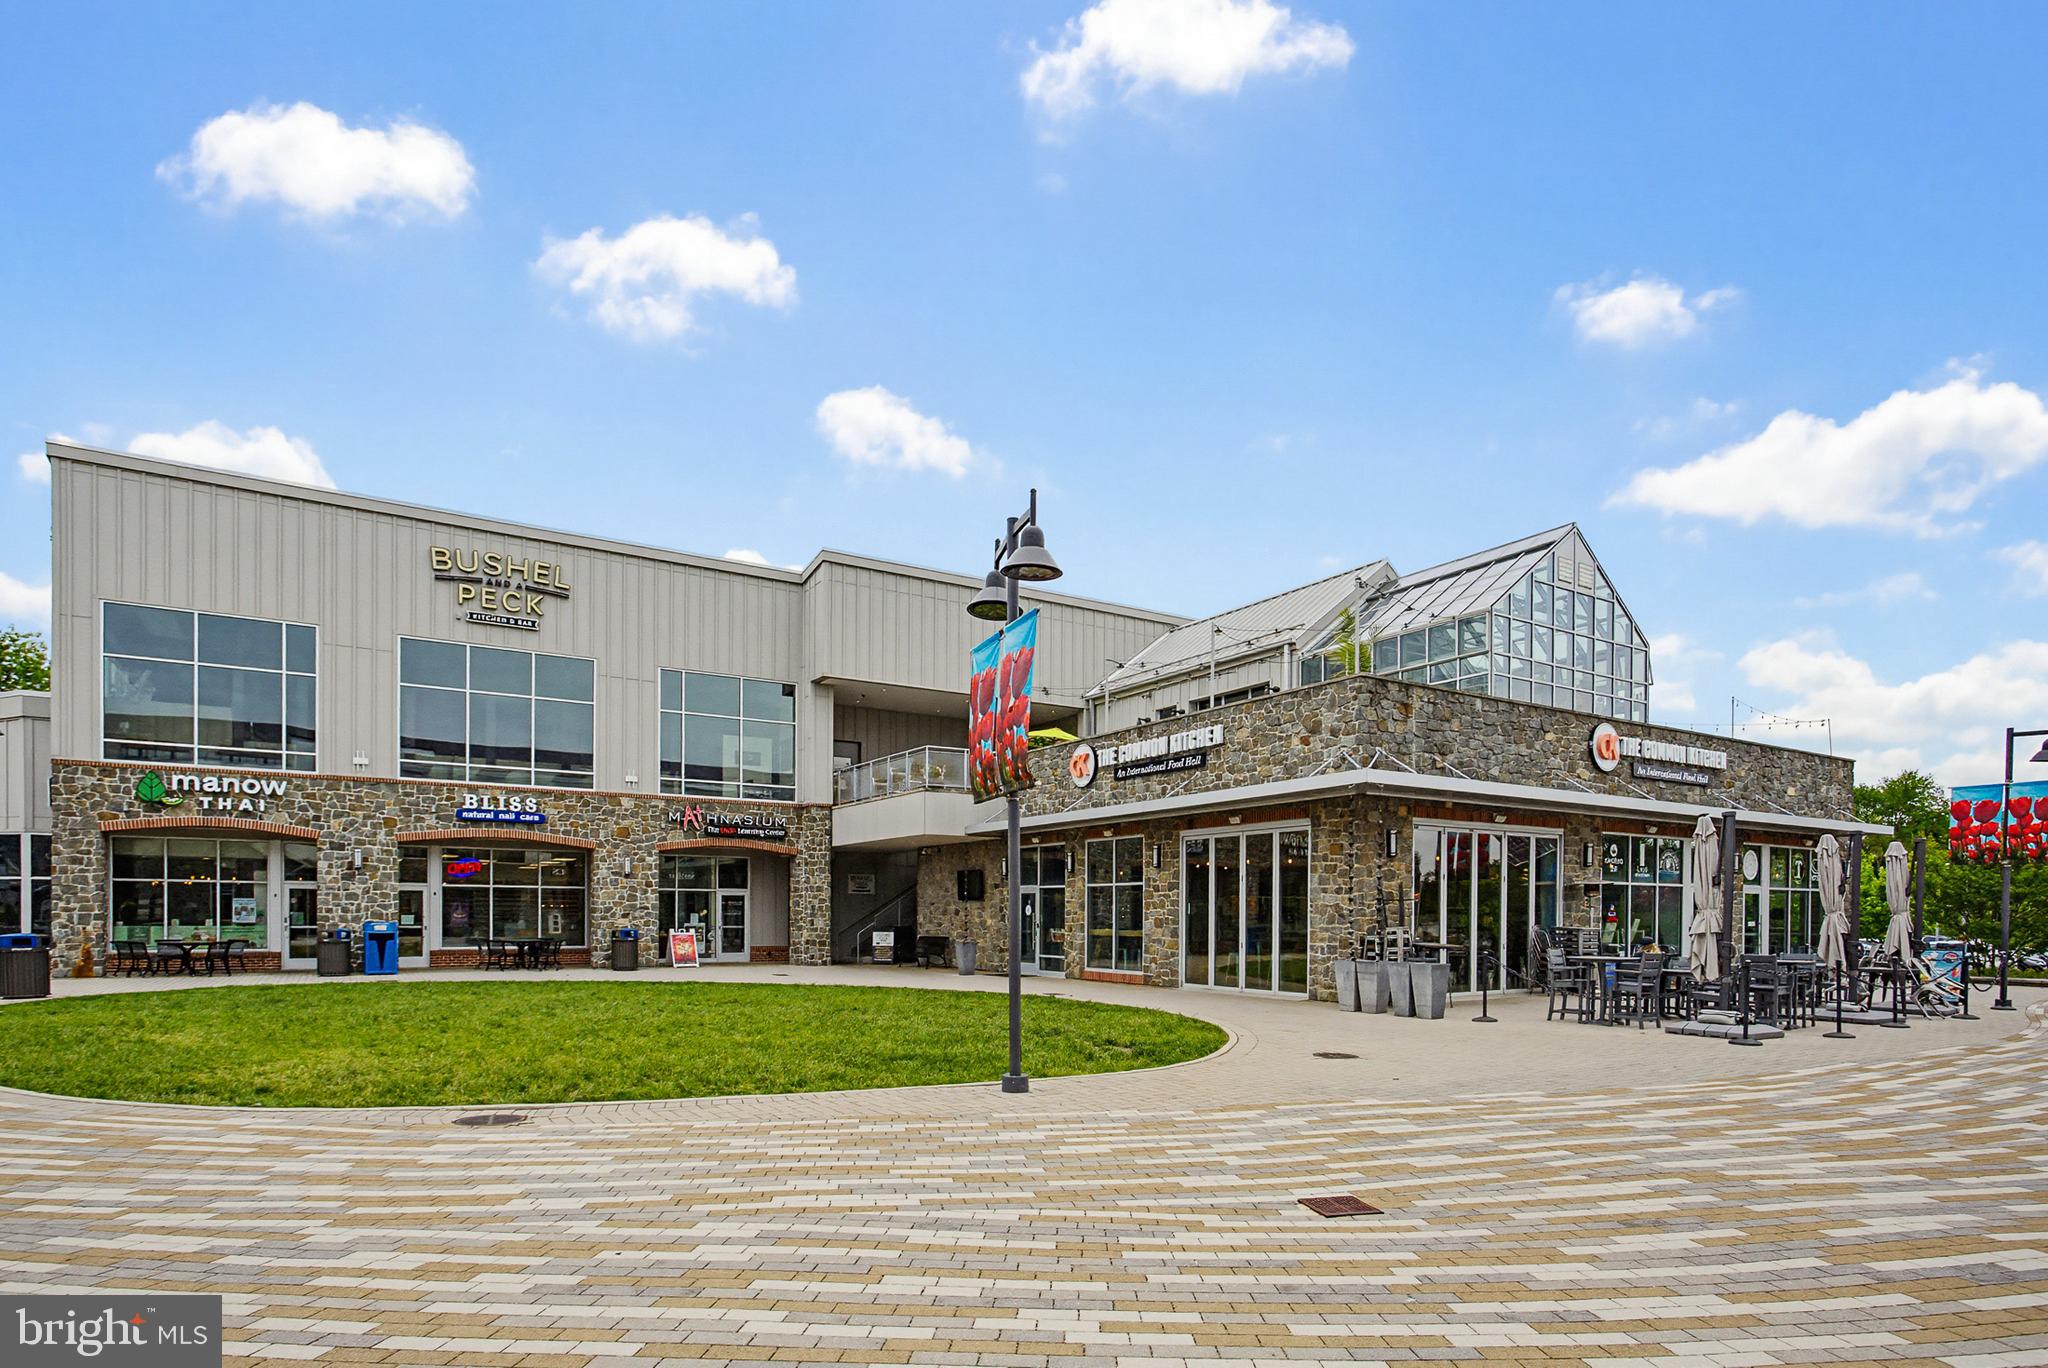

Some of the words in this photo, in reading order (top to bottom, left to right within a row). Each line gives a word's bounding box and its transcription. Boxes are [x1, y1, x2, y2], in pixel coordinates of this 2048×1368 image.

[430, 546, 571, 590] BUSHEL
[486, 577, 510, 588] AND
[515, 582, 523, 590] A
[458, 583, 544, 615] PECK
[472, 613, 507, 624] KITCHEN
[517, 619, 533, 627] BAR
[1097, 747, 1118, 768] THE
[1118, 736, 1168, 763] COMMON
[1169, 724, 1224, 754] KITCHEN
[1619, 736, 1641, 757] THE
[1641, 739, 1687, 763] COMMON
[1687, 746, 1727, 770] KITCHEN
[1117, 768, 1126, 778] An
[1126, 761, 1167, 777] International
[1167, 758, 1185, 770] Food
[1185, 755, 1202, 767] Hall
[172, 774, 287, 796] manow
[199, 796, 266, 812] THAI
[462, 793, 538, 813] BLISS
[462, 811, 494, 819] natural
[498, 812, 516, 820] nail
[737, 828, 765, 837] Learning
